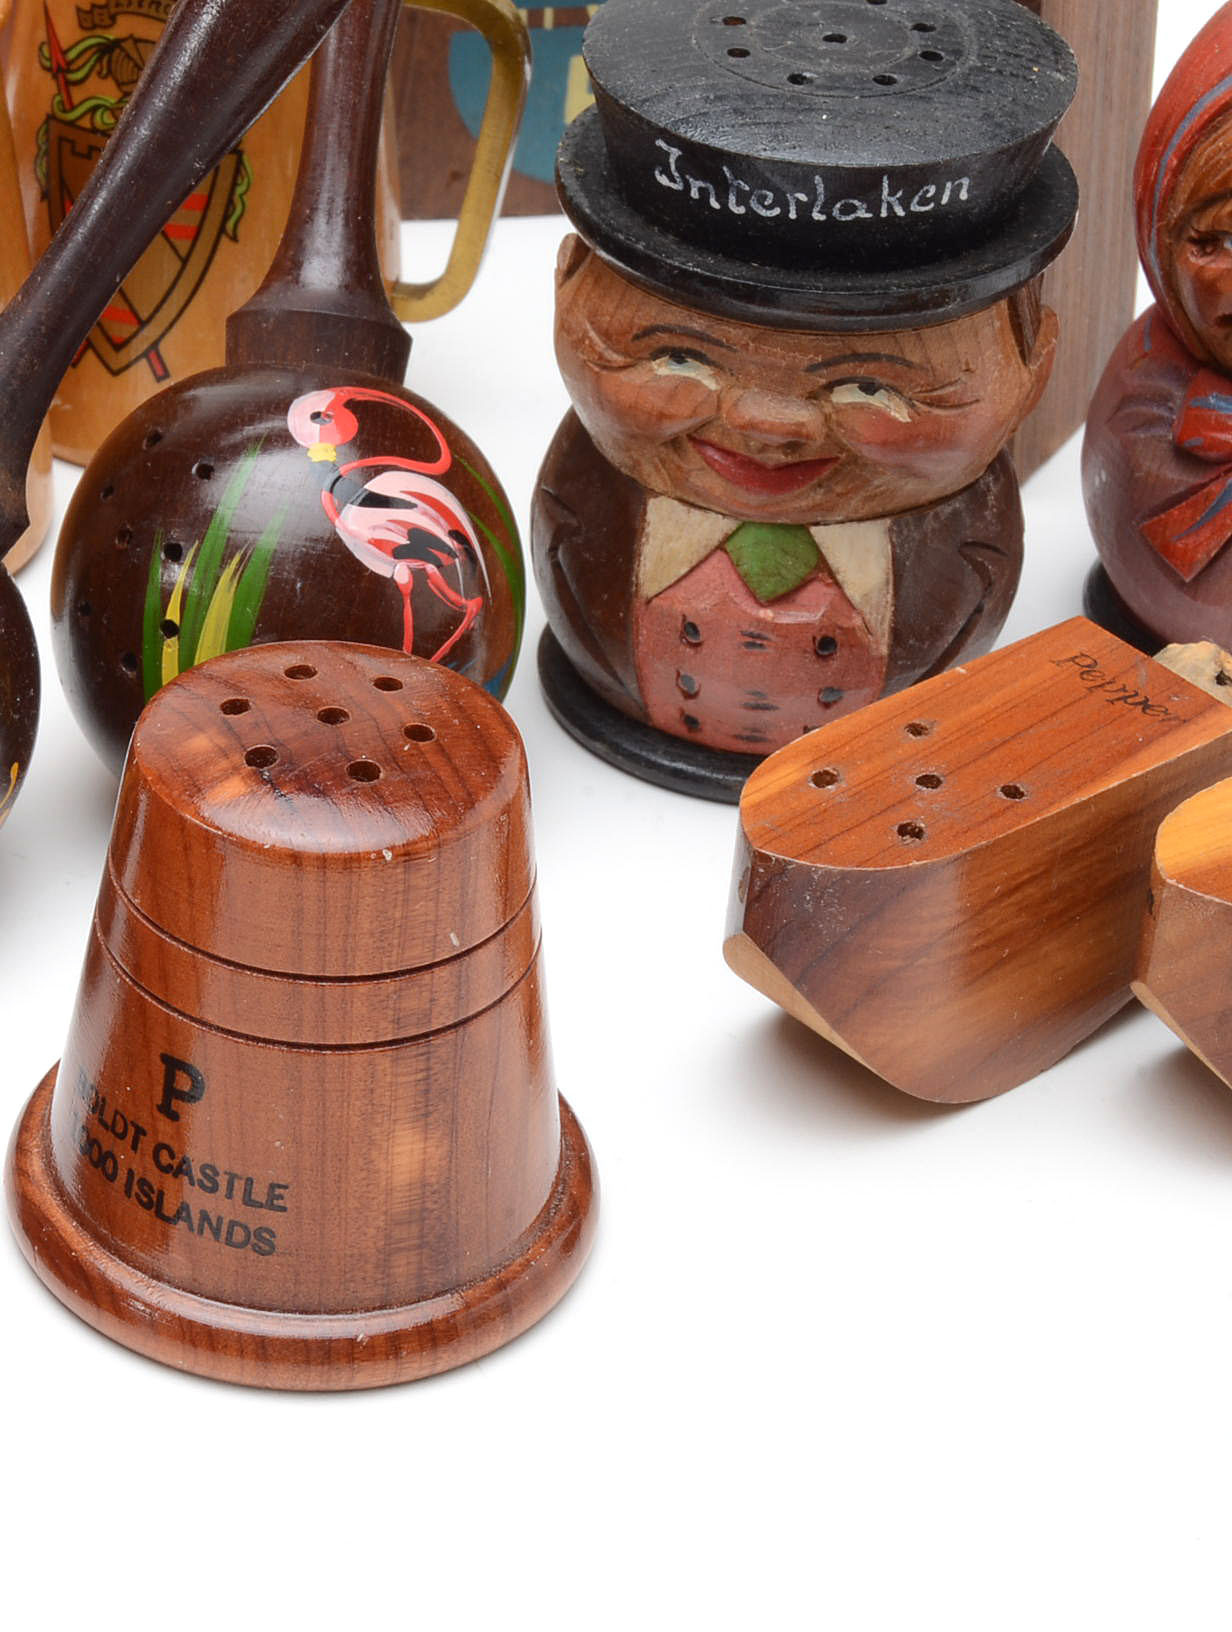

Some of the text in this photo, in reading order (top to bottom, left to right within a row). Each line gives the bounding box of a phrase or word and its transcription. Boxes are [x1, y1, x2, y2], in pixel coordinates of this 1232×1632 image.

[654, 138, 969, 221] Interlaken
[1050, 653, 1187, 724] Pepper
[156, 1053, 206, 1121] P
[124, 1168, 277, 1257] ISLANDS
[152, 1143, 289, 1213] CASTLE
